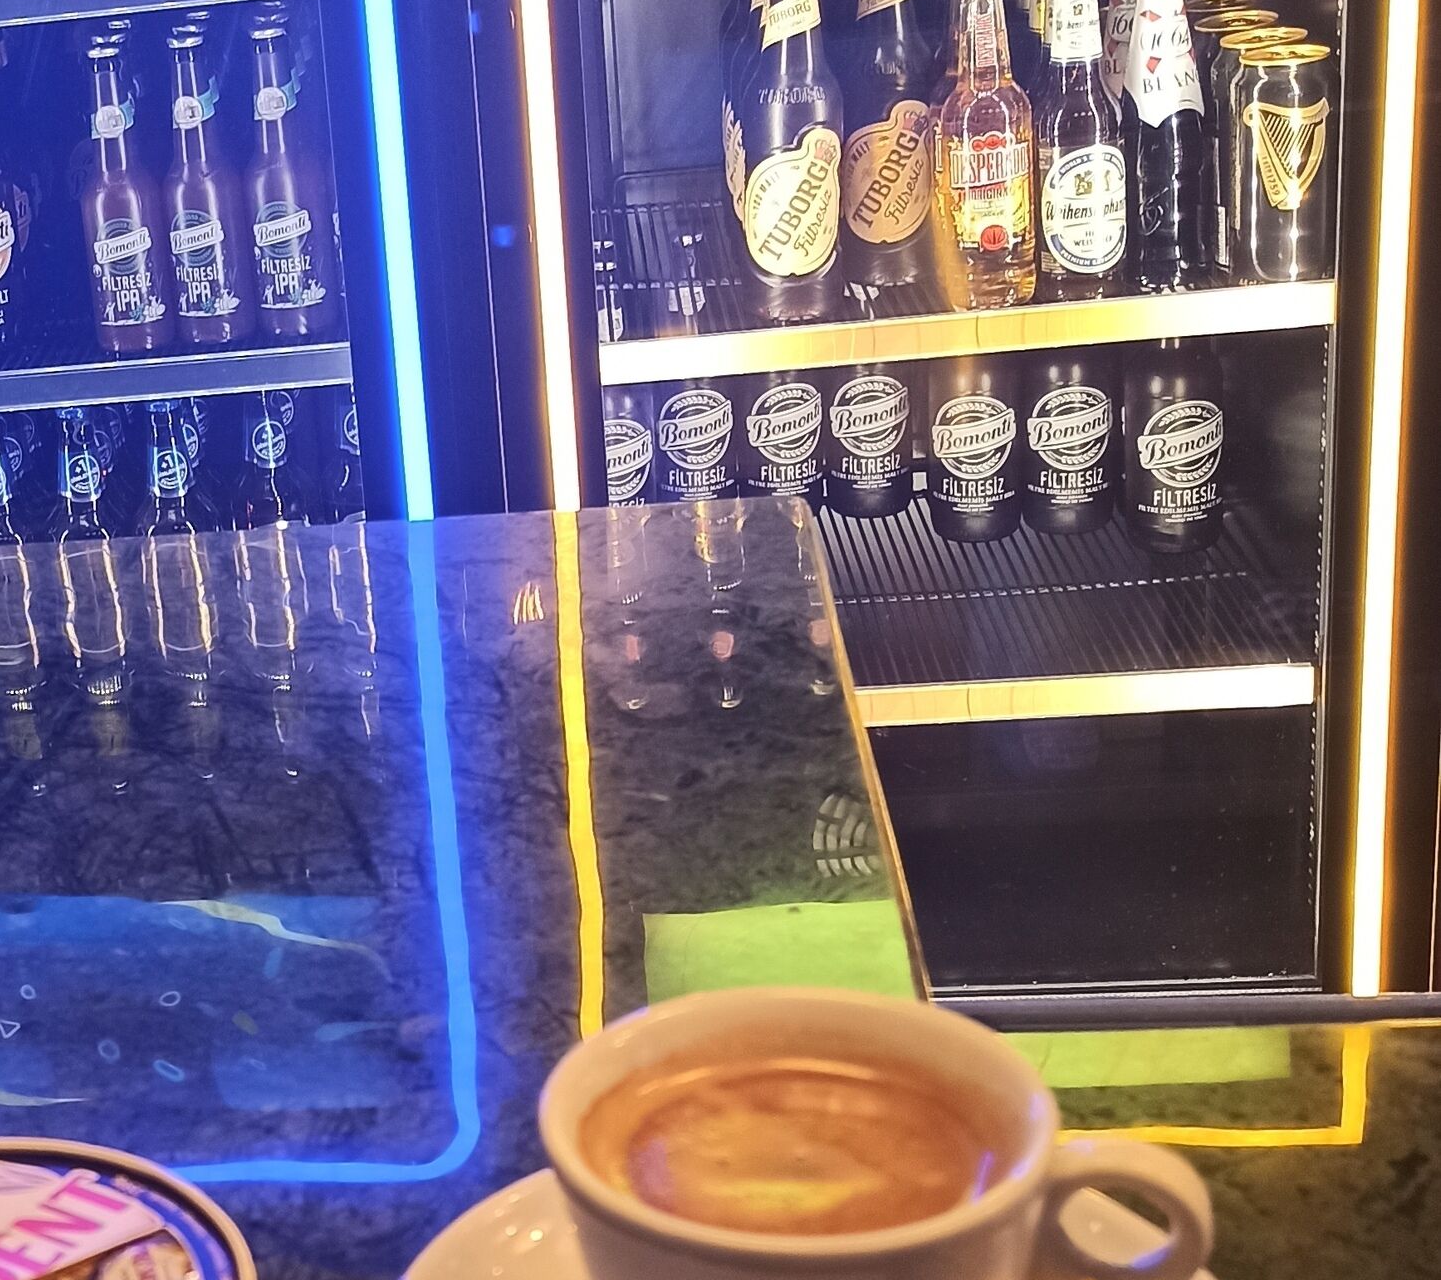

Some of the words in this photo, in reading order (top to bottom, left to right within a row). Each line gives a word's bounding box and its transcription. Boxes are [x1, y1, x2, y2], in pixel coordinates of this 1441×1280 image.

[853, 131, 920, 229] TUBORG
[884, 159, 924, 226] Filtresiz
[1265, 174, 1280, 196] 1759
[758, 160, 831, 261] TUBORG
[793, 189, 833, 258] Filtresiz
[97, 235, 148, 259] Bomonti
[258, 215, 307, 245] Bomonti
[115, 289, 141, 312] IPA
[188, 282, 212, 303] IPA
[274, 272, 300, 294] IPA
[661, 410, 731, 446] Bomonti
[753, 404, 822, 442] Bomonti
[834, 395, 908, 434] Bomonti
[1034, 407, 1110, 446] Bomonti
[937, 418, 1012, 453] Bomonti
[1145, 422, 1223, 465] Bomonti
